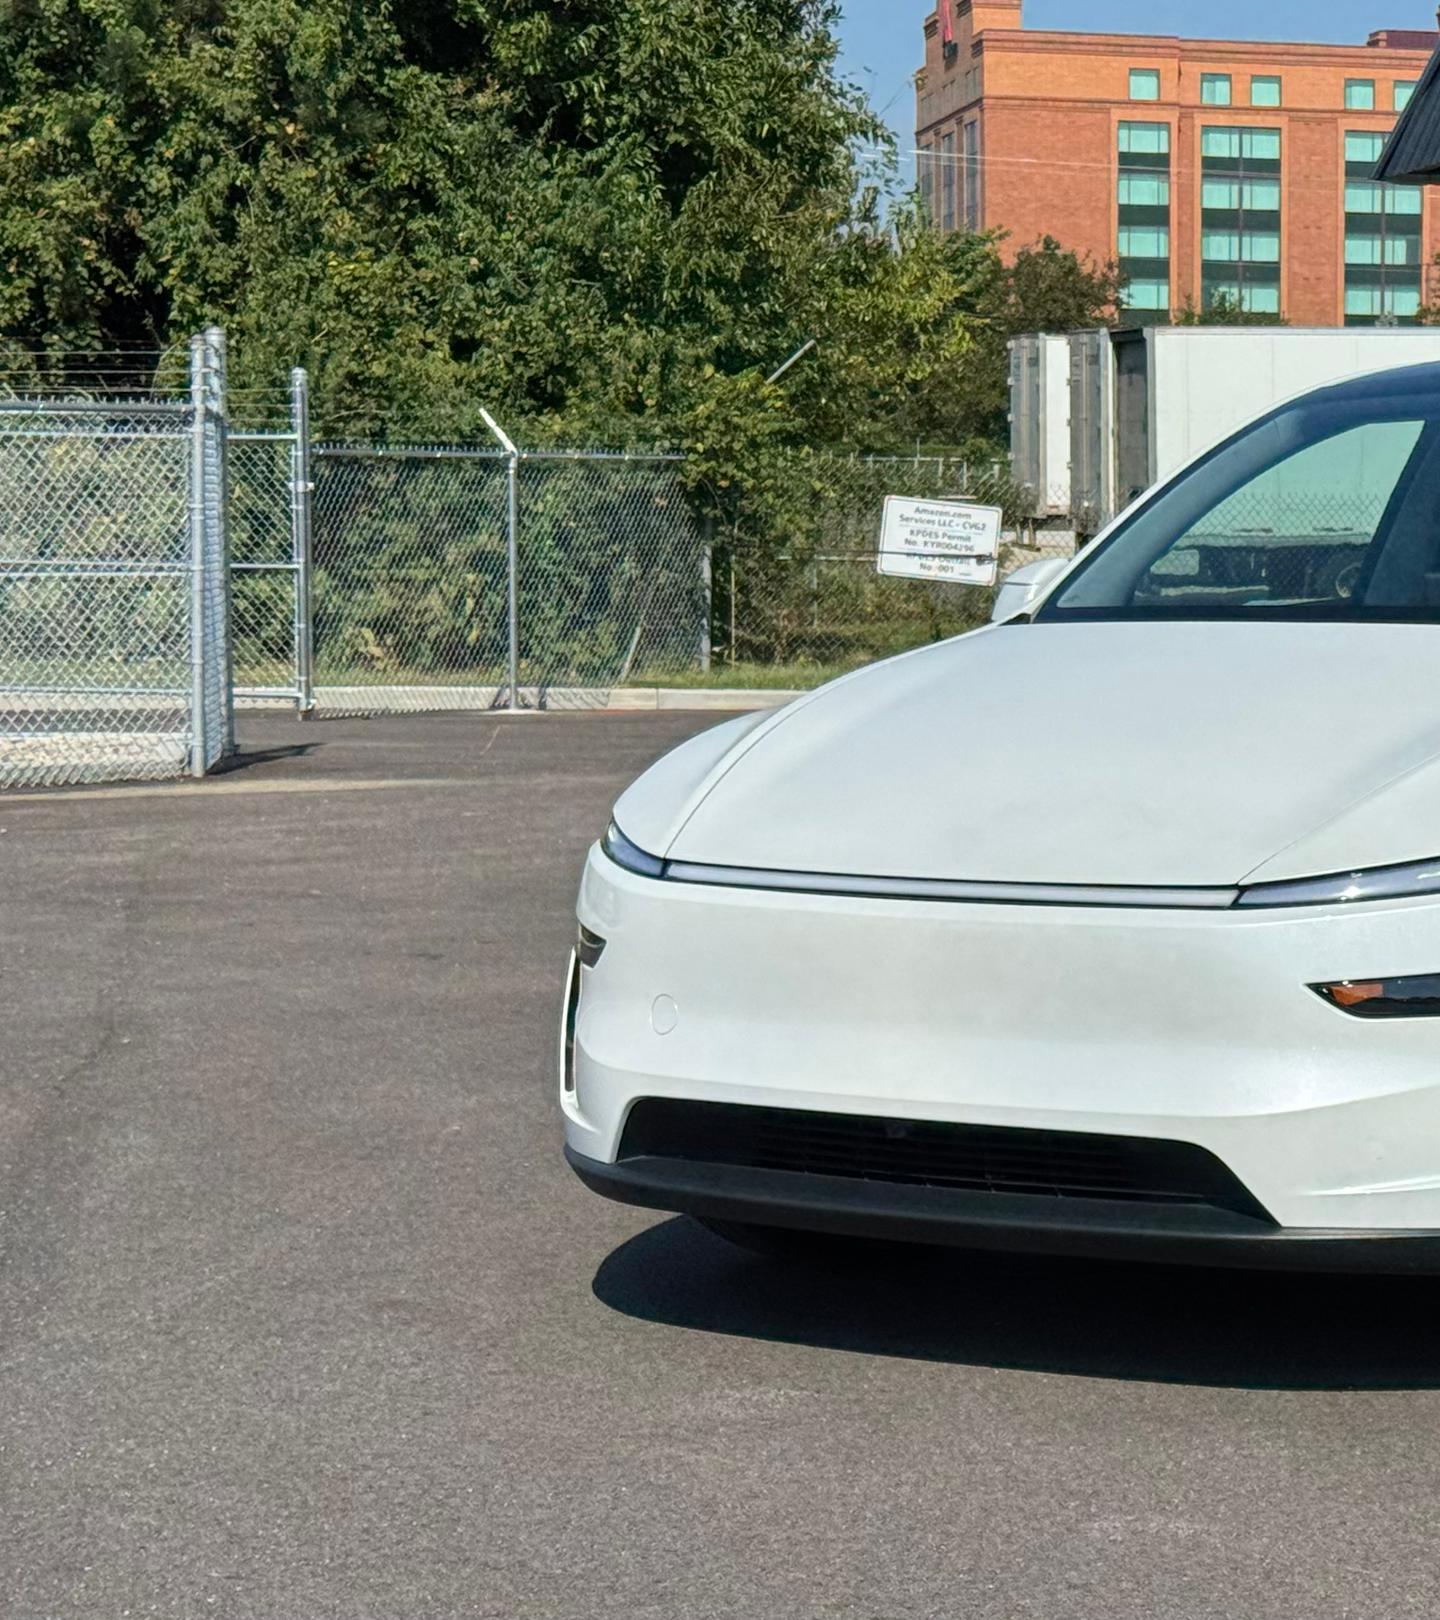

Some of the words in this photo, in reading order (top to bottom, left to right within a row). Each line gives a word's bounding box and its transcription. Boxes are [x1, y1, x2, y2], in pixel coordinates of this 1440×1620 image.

[914, 506, 972, 519] Amazon.com
[899, 514, 936, 525] Services
[937, 518, 954, 528] LLC
[962, 520, 987, 531] CVG2
[942, 533, 972, 543] Permit
